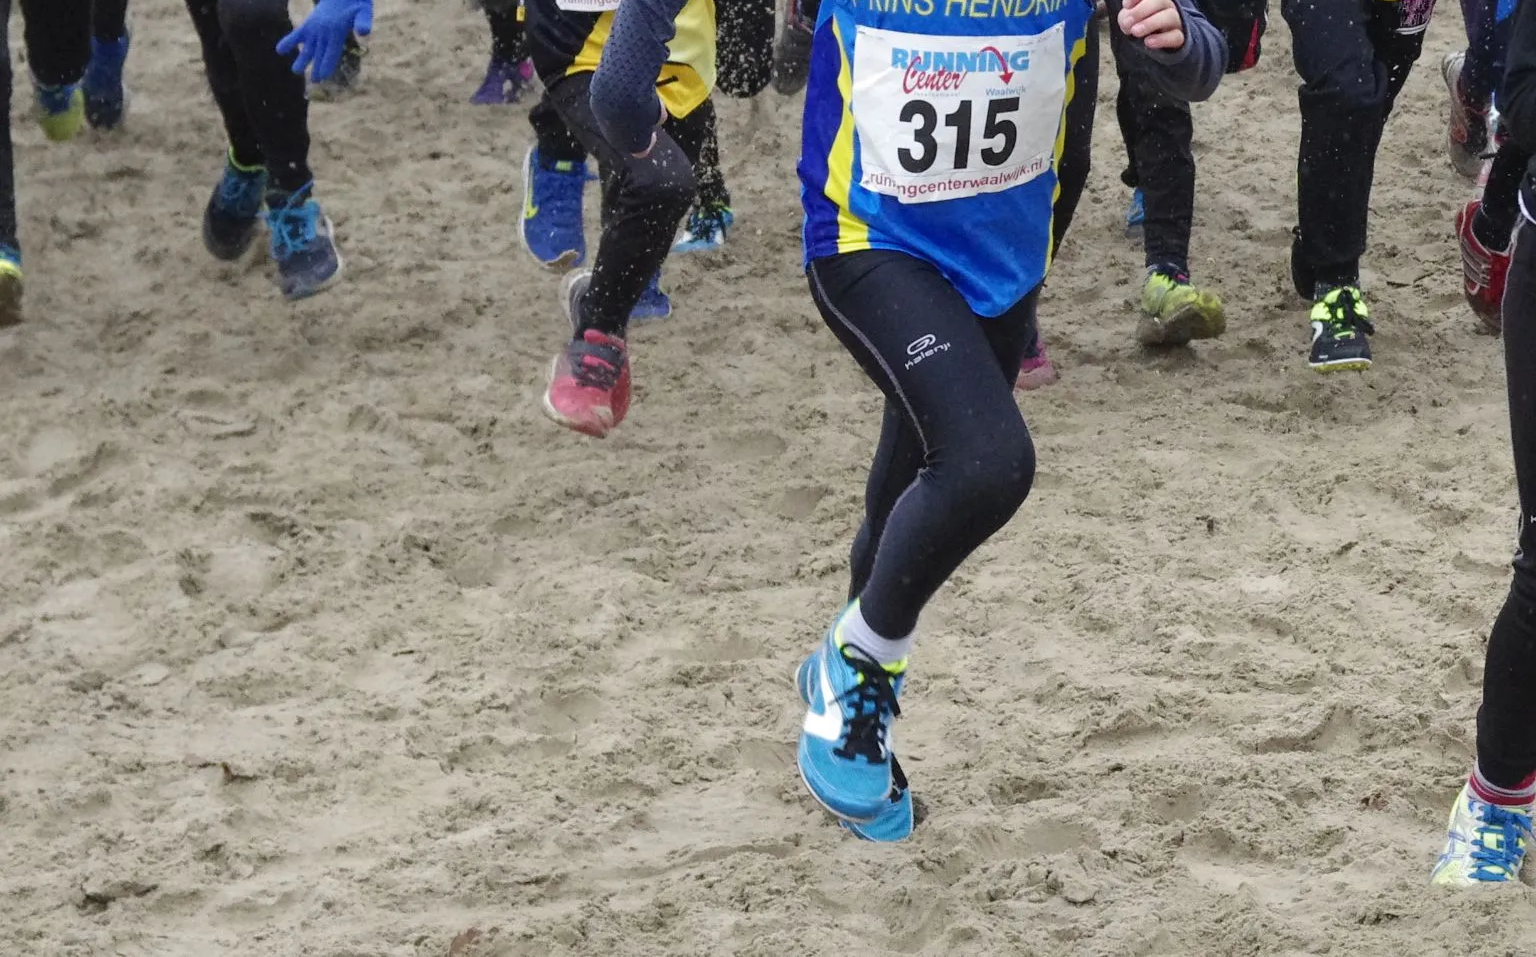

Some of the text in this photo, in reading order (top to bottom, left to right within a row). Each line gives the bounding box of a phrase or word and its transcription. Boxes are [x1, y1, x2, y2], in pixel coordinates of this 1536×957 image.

[891, 47, 1029, 73] RUNNING
[902, 56, 967, 94] Center
[985, 85, 1026, 97] Waalwijk
[897, 97, 1020, 174] 315
[870, 158, 1043, 198] runngcenterwaalwijk.nl
[904, 342, 951, 371] Kalenji
